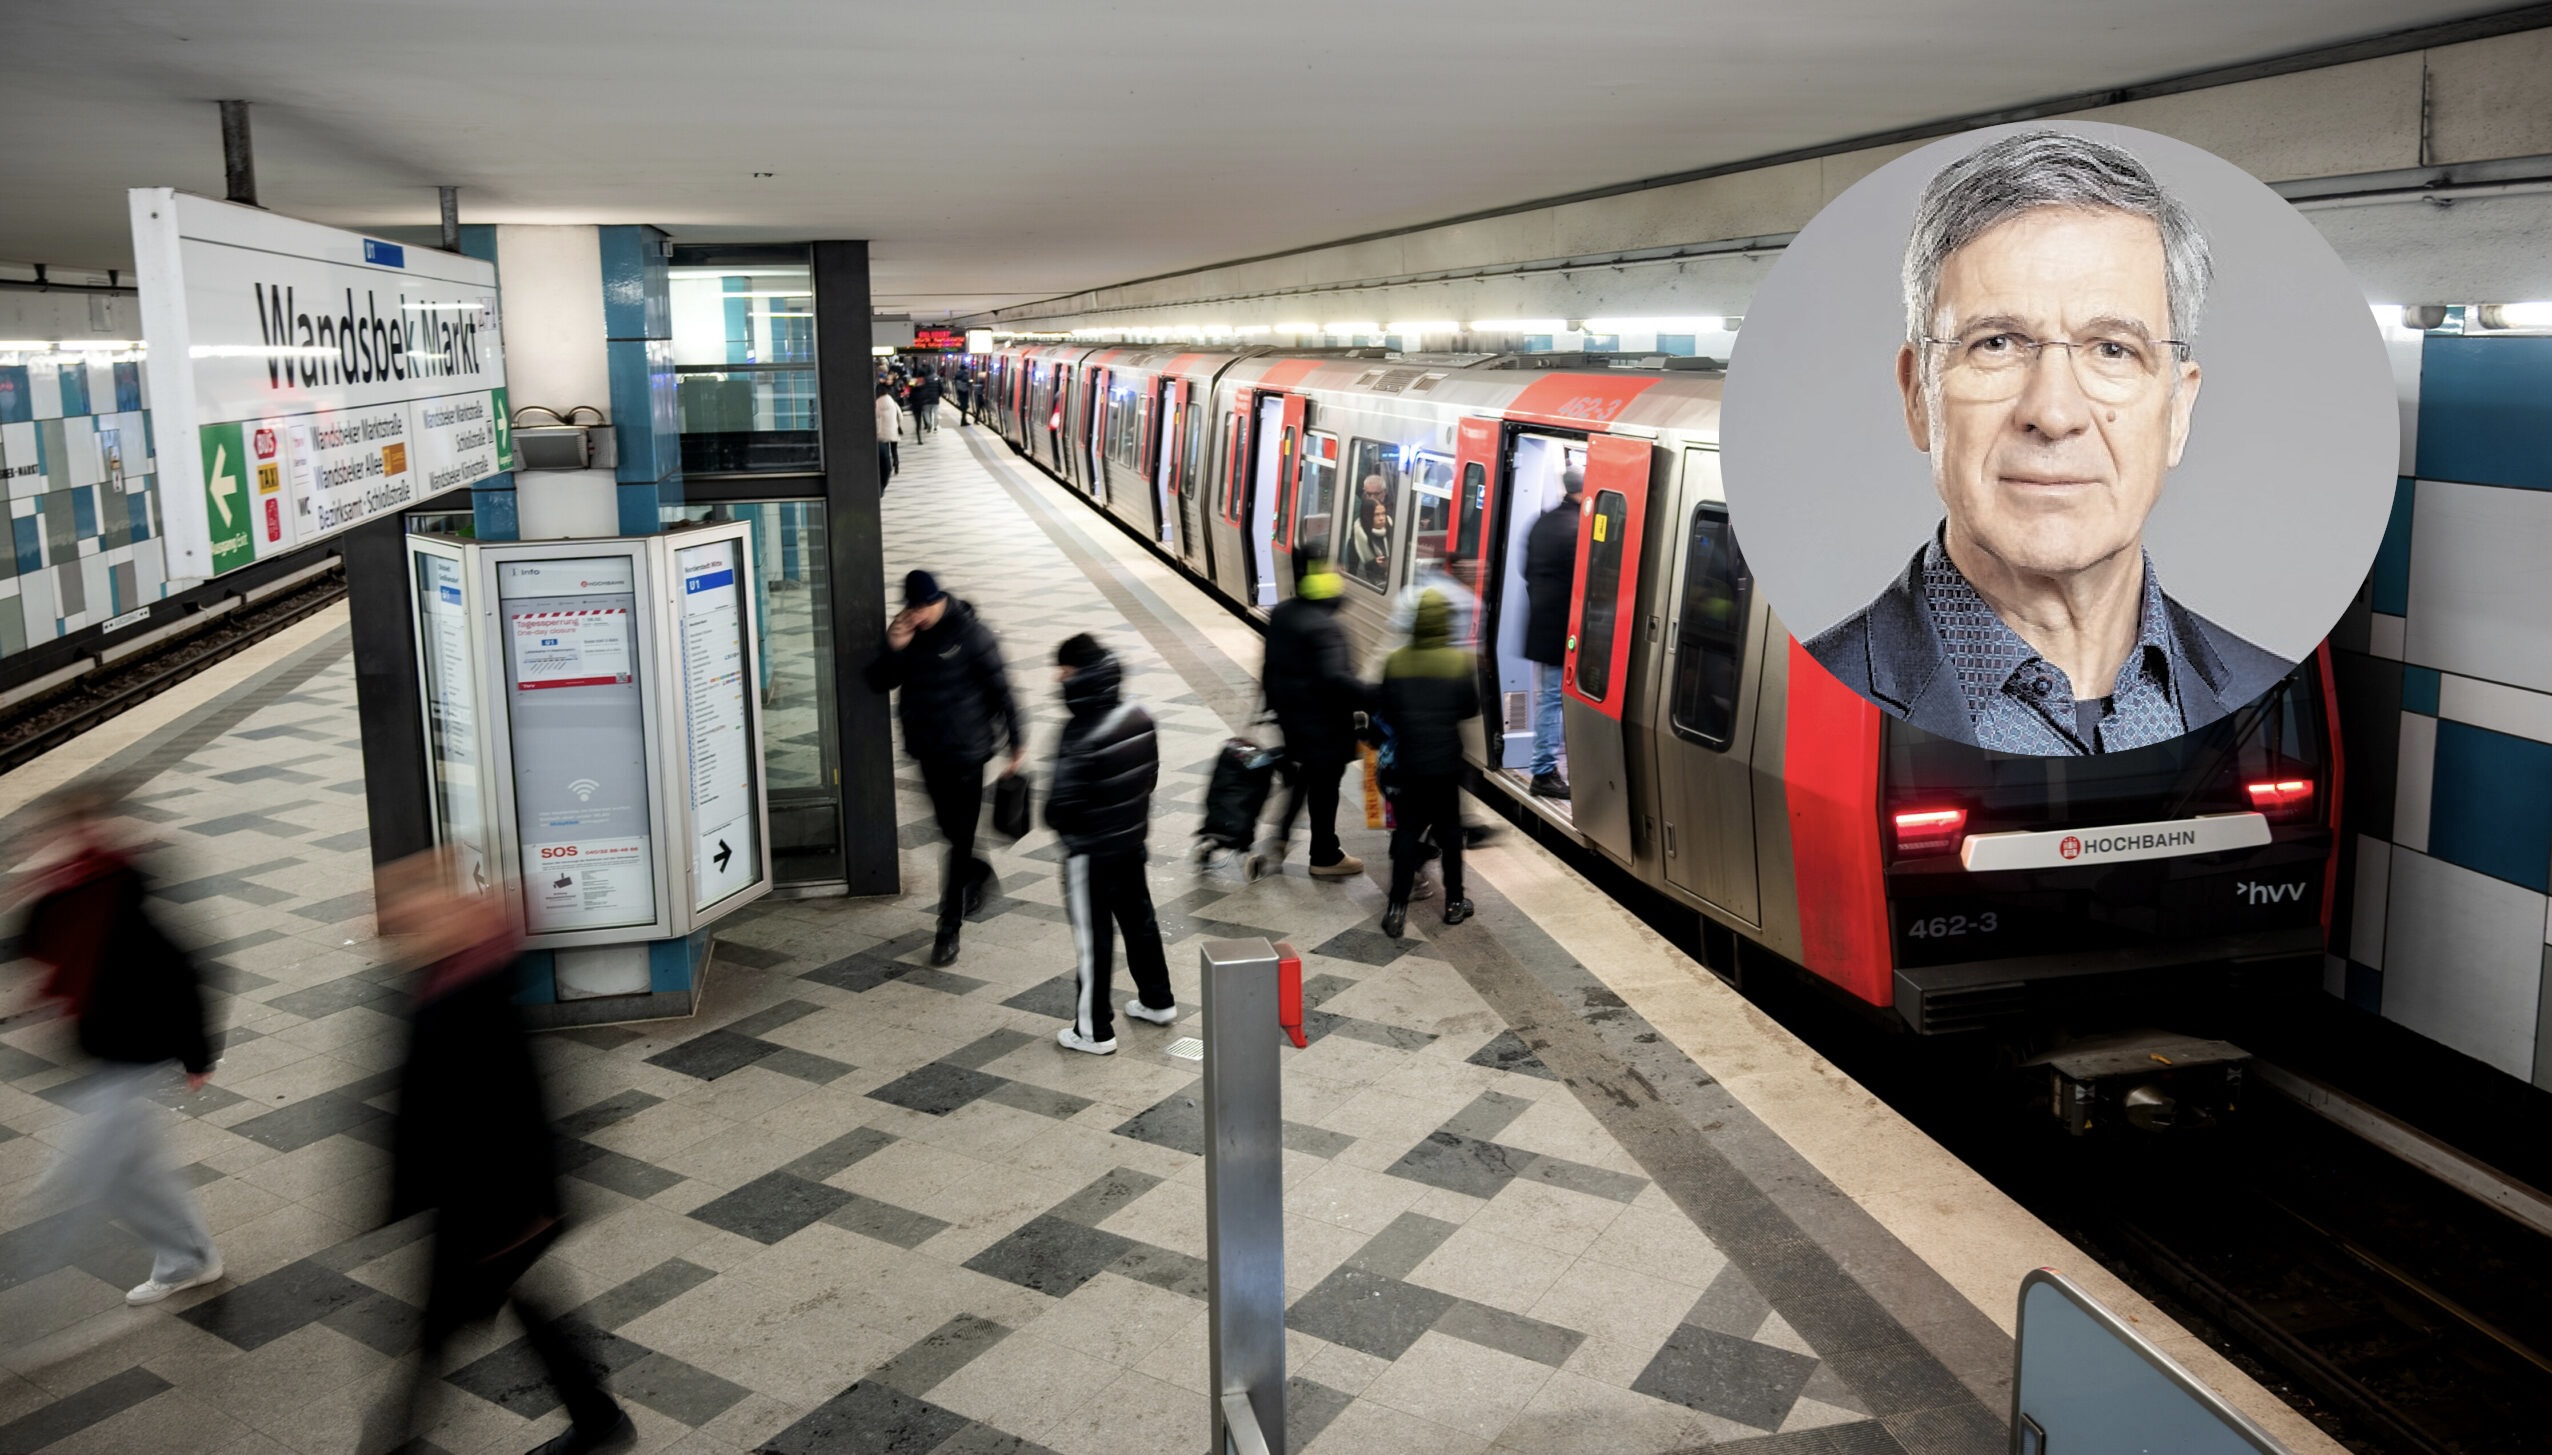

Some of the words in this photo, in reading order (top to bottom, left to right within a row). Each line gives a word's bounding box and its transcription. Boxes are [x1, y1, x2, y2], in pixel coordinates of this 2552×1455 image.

[254, 282, 420, 389] Wandsbek
[420, 299, 480, 377] Markt
[1557, 396, 1622, 420] 462-3
[256, 432, 275, 454] BUS
[310, 420, 361, 451] Wandsbeker
[361, 413, 404, 441] Marktstraße
[258, 468, 280, 490] TAXI
[314, 457, 365, 490] Wandsbeker
[365, 452, 384, 476] Allee
[318, 497, 364, 530] Bezirksamt
[521, 568, 540, 576] Info
[688, 579, 701, 591] U1
[516, 618, 580, 630] Tagessperrung
[540, 845, 578, 858] SOS
[2083, 829, 2196, 855] HOCHBAHN
[1908, 912, 1998, 939] 462-3
